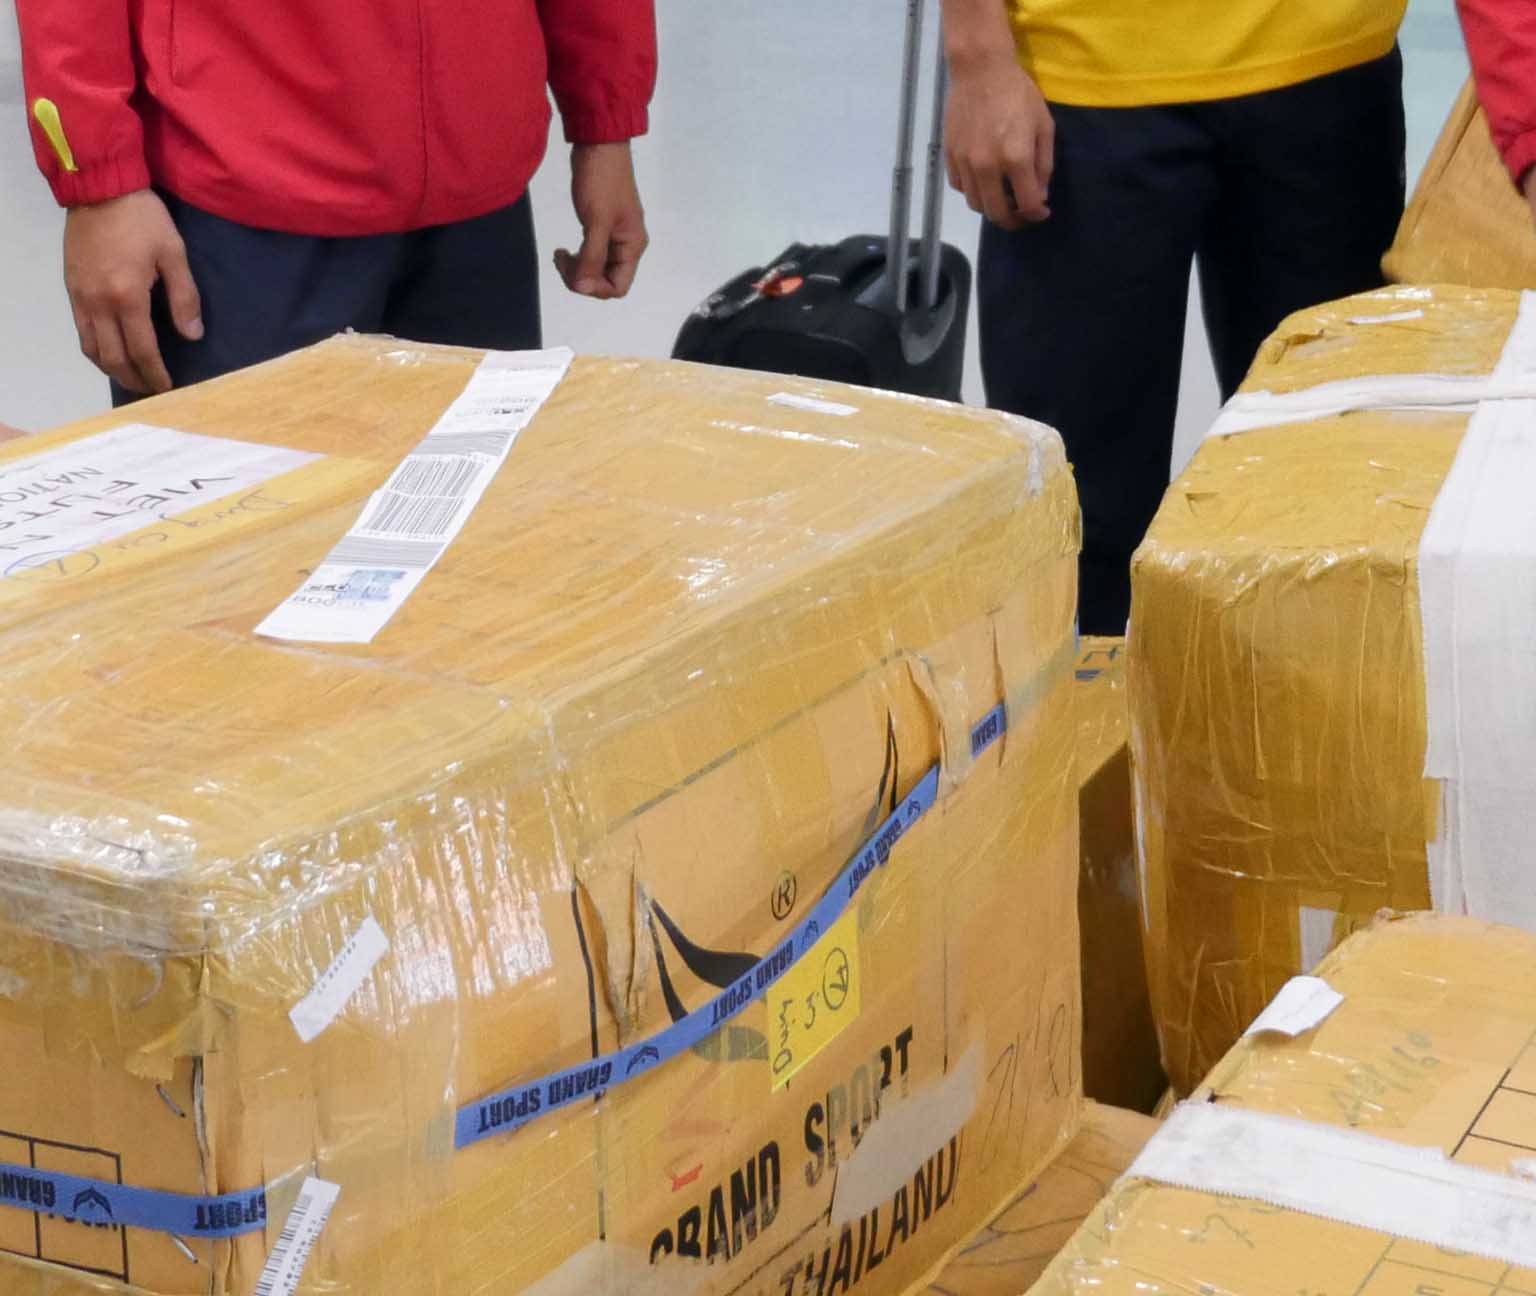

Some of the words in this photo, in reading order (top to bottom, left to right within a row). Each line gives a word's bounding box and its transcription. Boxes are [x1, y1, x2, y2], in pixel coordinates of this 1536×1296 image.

[87, 473, 234, 523] VIET
[755, 947, 795, 999] GRAND
[711, 981, 754, 1026] SPORT
[548, 1061, 613, 1103] GRAND
[478, 1088, 542, 1134] SPORT
[776, 1136, 960, 1296] THAILAND
